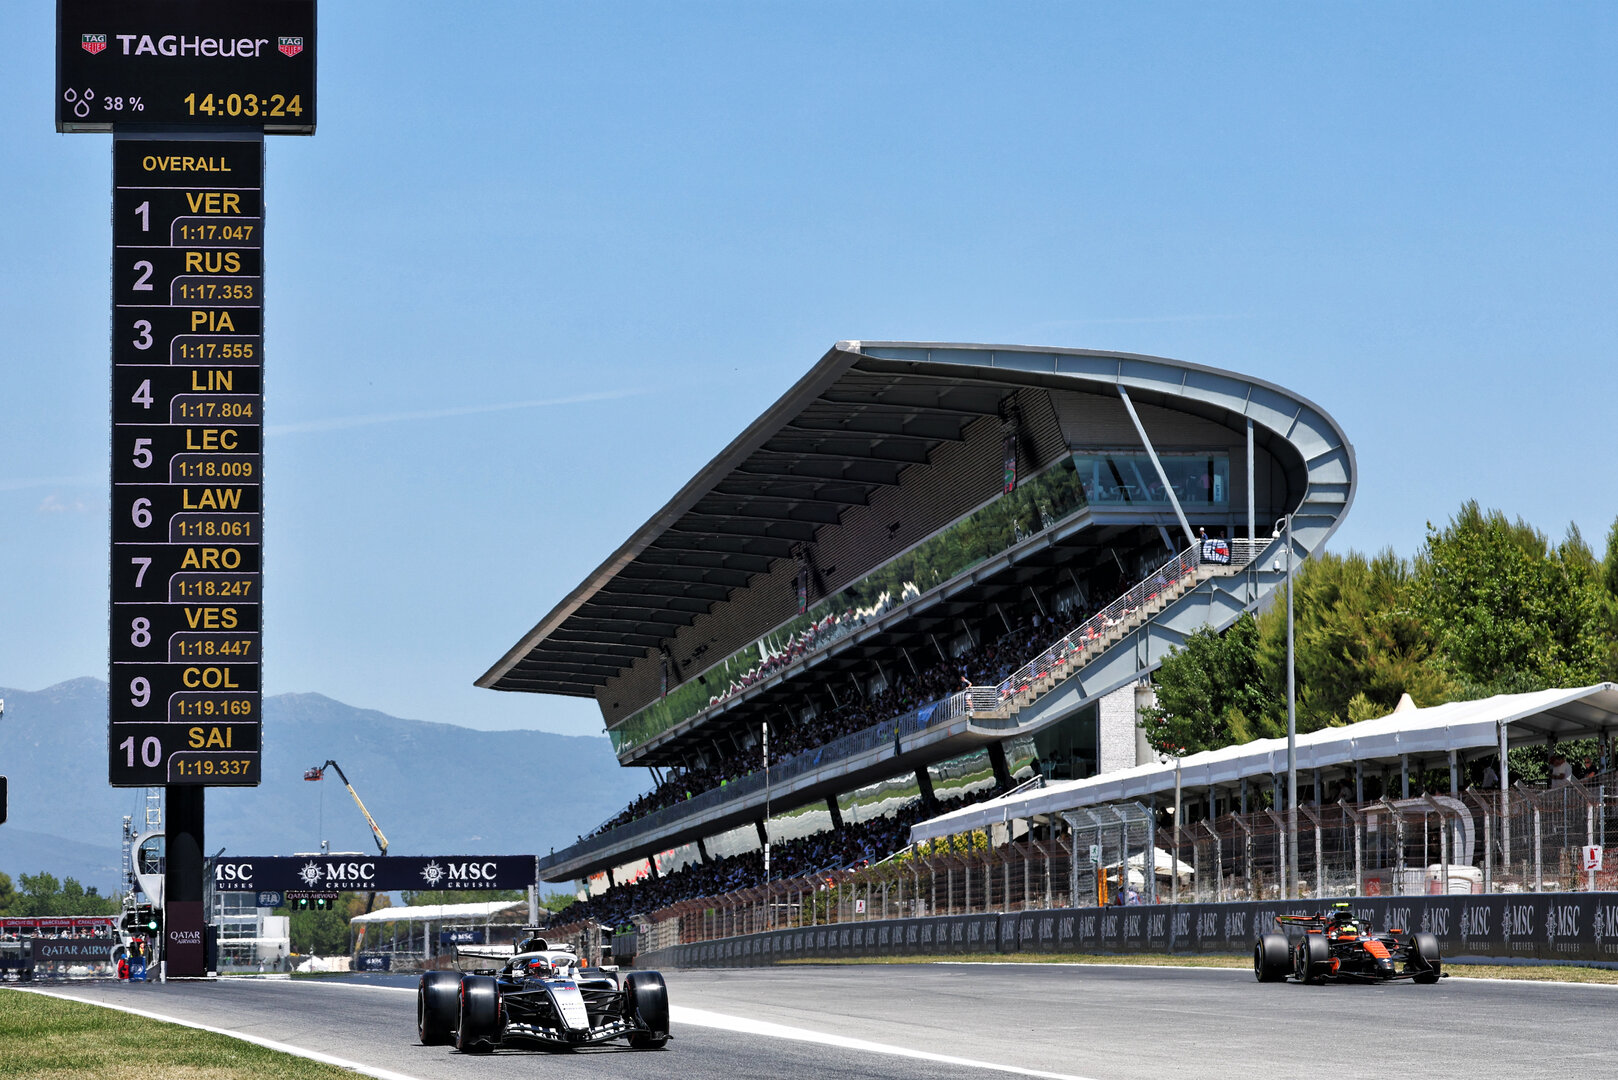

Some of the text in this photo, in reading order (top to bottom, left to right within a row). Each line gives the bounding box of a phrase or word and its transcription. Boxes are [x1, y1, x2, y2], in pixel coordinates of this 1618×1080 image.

[84, 34, 105, 43] TAG
[279, 37, 303, 46] TAG
[103, 96, 145, 112] 38 %
[184, 92, 303, 117] 14:03:24
[142, 155, 232, 172] OVERALL
[186, 193, 240, 213] VER
[135, 202, 149, 231] 1
[181, 226, 253, 240] 1:17.047
[186, 252, 240, 272] RUS
[132, 261, 153, 290] 2
[180, 285, 253, 299] 1:17.353
[191, 311, 235, 331] PIA
[132, 320, 153, 349] 3
[180, 344, 253, 358] 1:17.555
[192, 371, 233, 390] LIN
[132, 380, 153, 408] 4
[180, 403, 253, 417] 1:17.804
[187, 429, 238, 449] LEC
[132, 439, 153, 468] 5
[179, 462, 252, 476] 1:18.009
[183, 489, 241, 509] LAW
[131, 498, 152, 528] 6
[178, 522, 251, 536] 1:18.061
[181, 548, 241, 568] ARO
[131, 557, 152, 587] 7
[178, 582, 252, 596] 1:18.247
[185, 608, 237, 628] VES
[131, 617, 152, 647] 8
[178, 641, 251, 655] 1:18.447
[183, 668, 239, 688] COL
[130, 676, 151, 707] 9
[177, 701, 251, 715] 1:19.169
[188, 728, 232, 747] SAI
[120, 736, 162, 767] 10
[177, 760, 251, 775] 1:19.337
[326, 862, 375, 880] MSC
[447, 862, 497, 880] MSC
[259, 893, 279, 904] FIA
[1203, 913, 1218, 936] MSC
[1231, 912, 1246, 936] MSC
[1393, 907, 1411, 935] MSC
[1430, 907, 1450, 936] MSC
[1469, 906, 1491, 936] MSC
[1512, 904, 1535, 936] MSC
[1556, 904, 1580, 937] MSC
[170, 931, 201, 942] QATAR
[1512, 941, 1534, 951] CRUISES
[41, 945, 111, 957] QATAR AIRW
[1556, 943, 1580, 953] CRUISES
